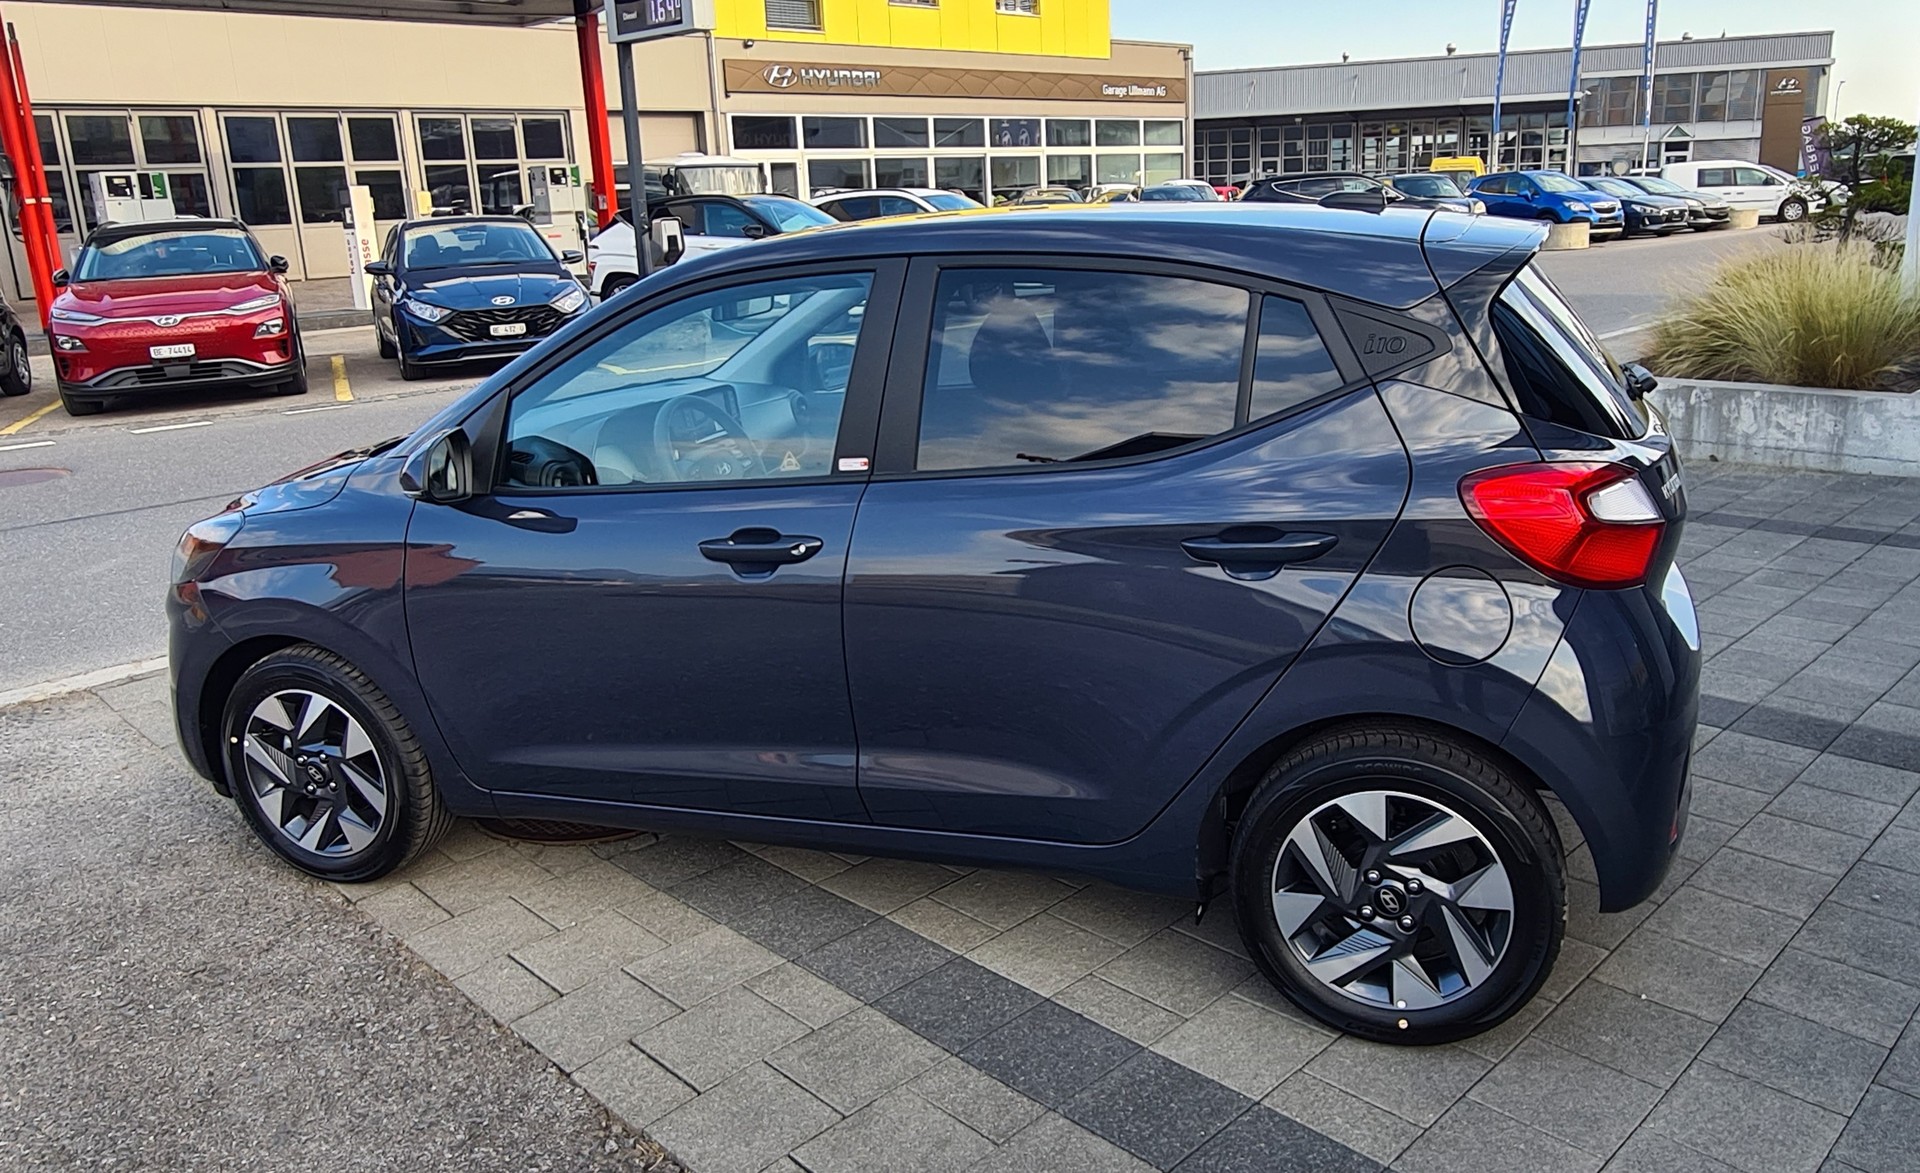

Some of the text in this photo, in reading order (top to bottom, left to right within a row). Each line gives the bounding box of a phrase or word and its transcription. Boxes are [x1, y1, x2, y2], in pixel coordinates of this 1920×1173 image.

[800, 68, 881, 88] HYUNDAI
[1102, 84, 1127, 98] Garage
[1156, 86, 1167, 97] AG
[361, 239, 372, 275] asse
[1363, 333, 1407, 354] i10
